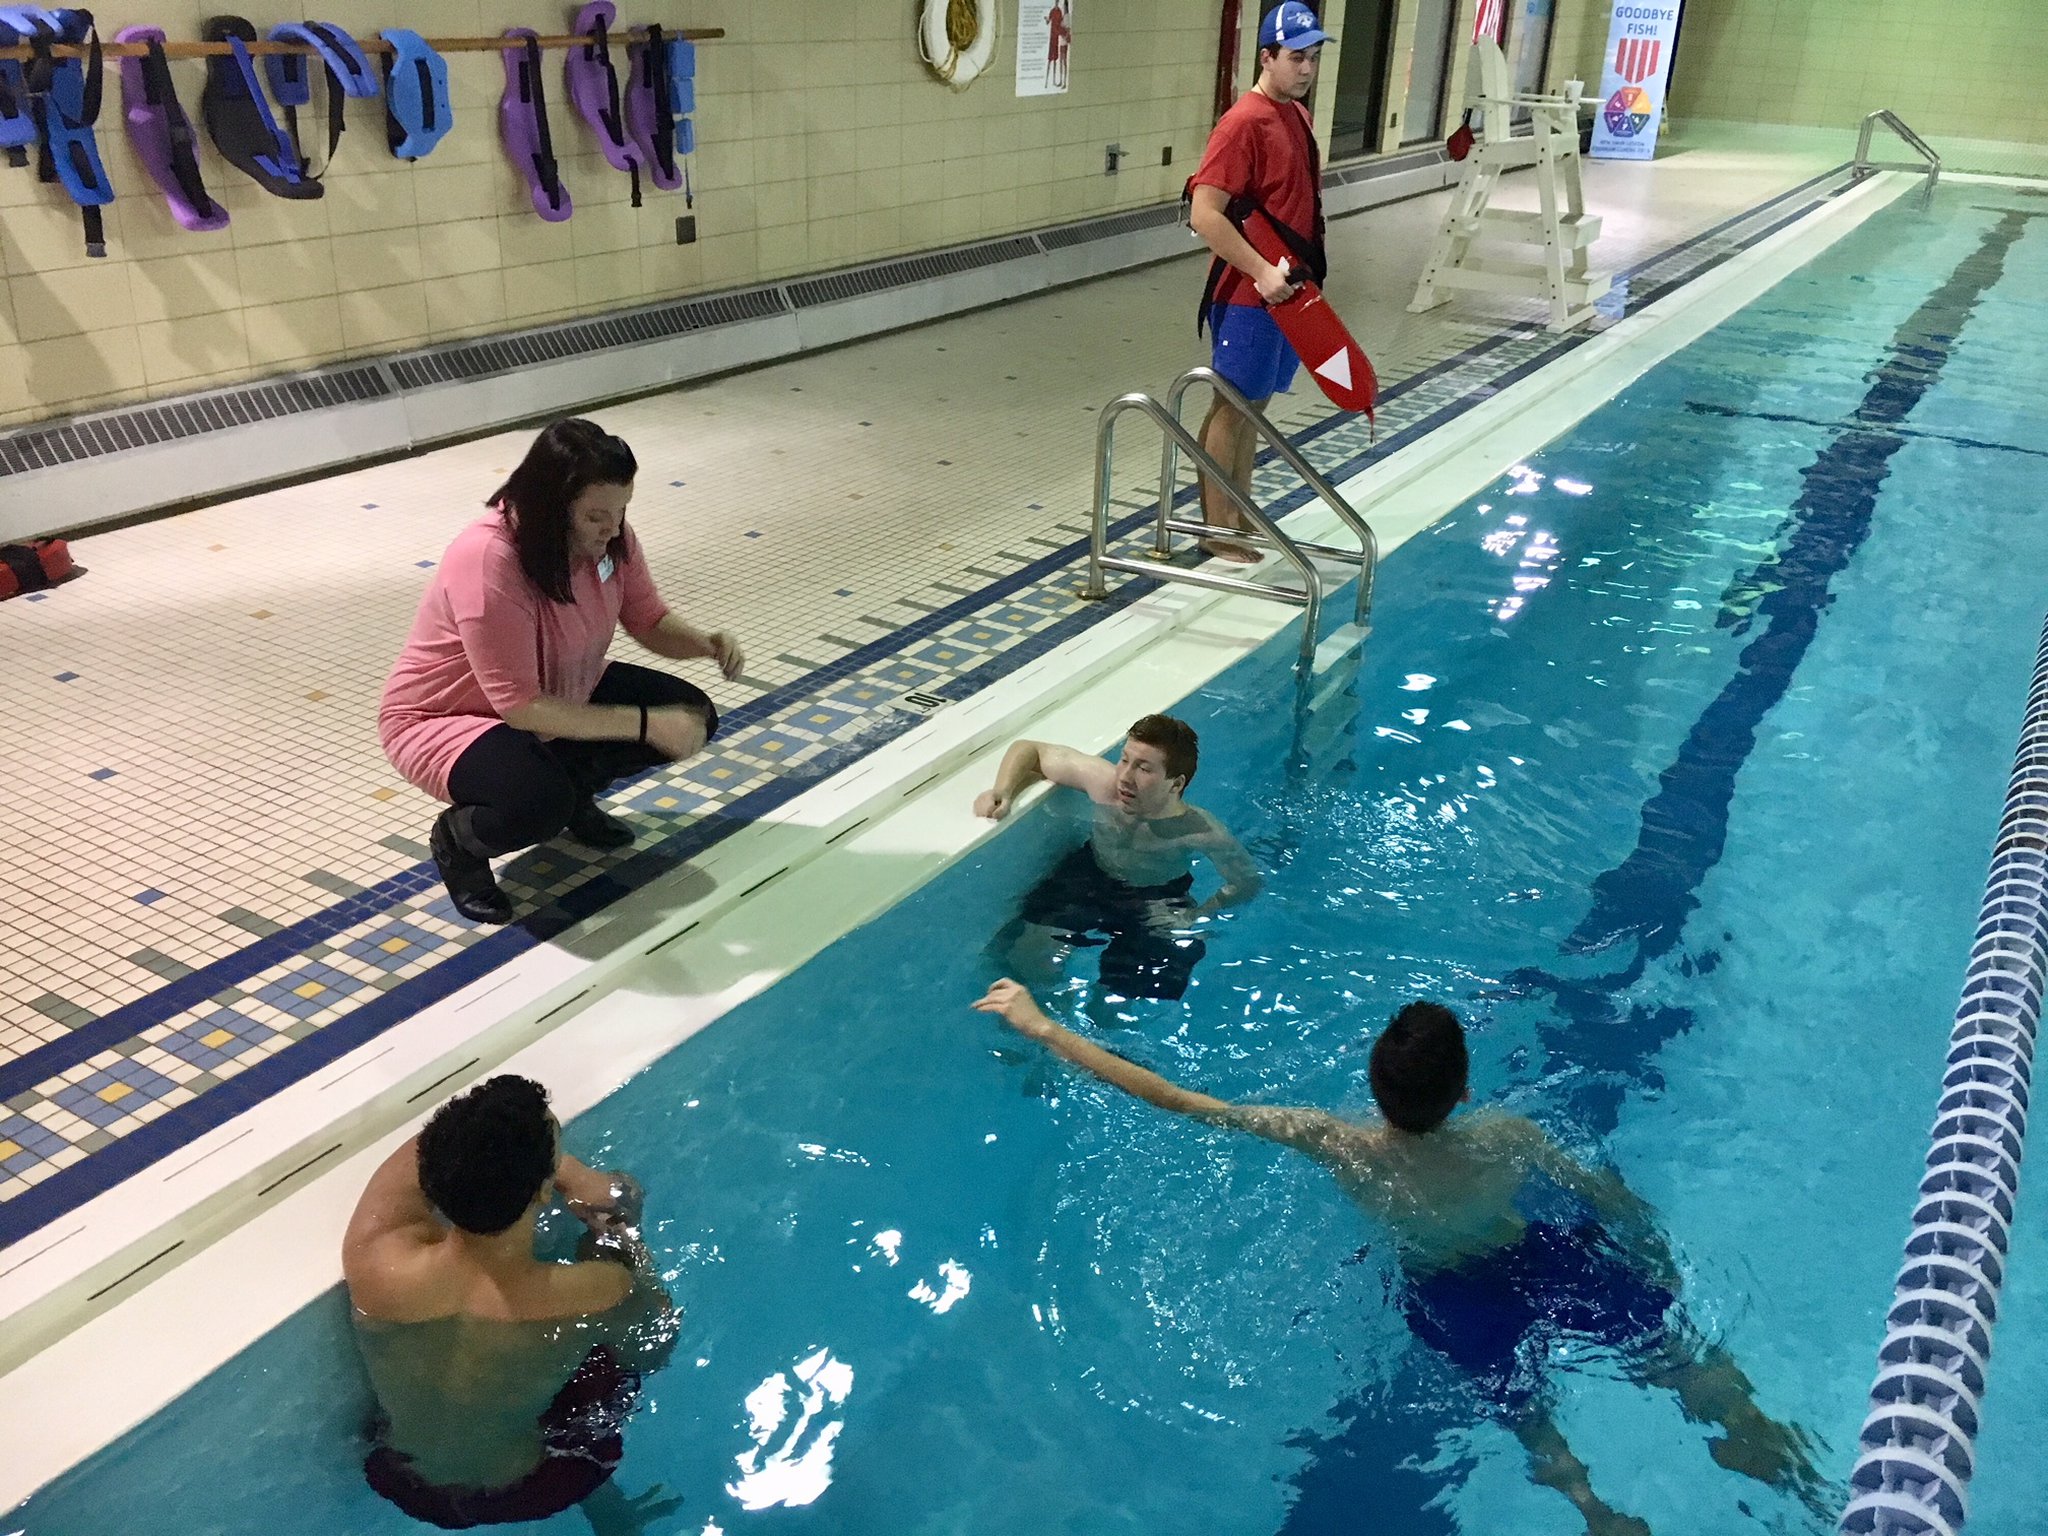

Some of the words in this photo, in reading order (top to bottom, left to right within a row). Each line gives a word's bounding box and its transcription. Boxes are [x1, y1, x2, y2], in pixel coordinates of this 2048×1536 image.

[1615, 6, 1674, 21] GOODBYE
[1626, 23, 1658, 36] FISH!
[904, 692, 947, 708] 10
